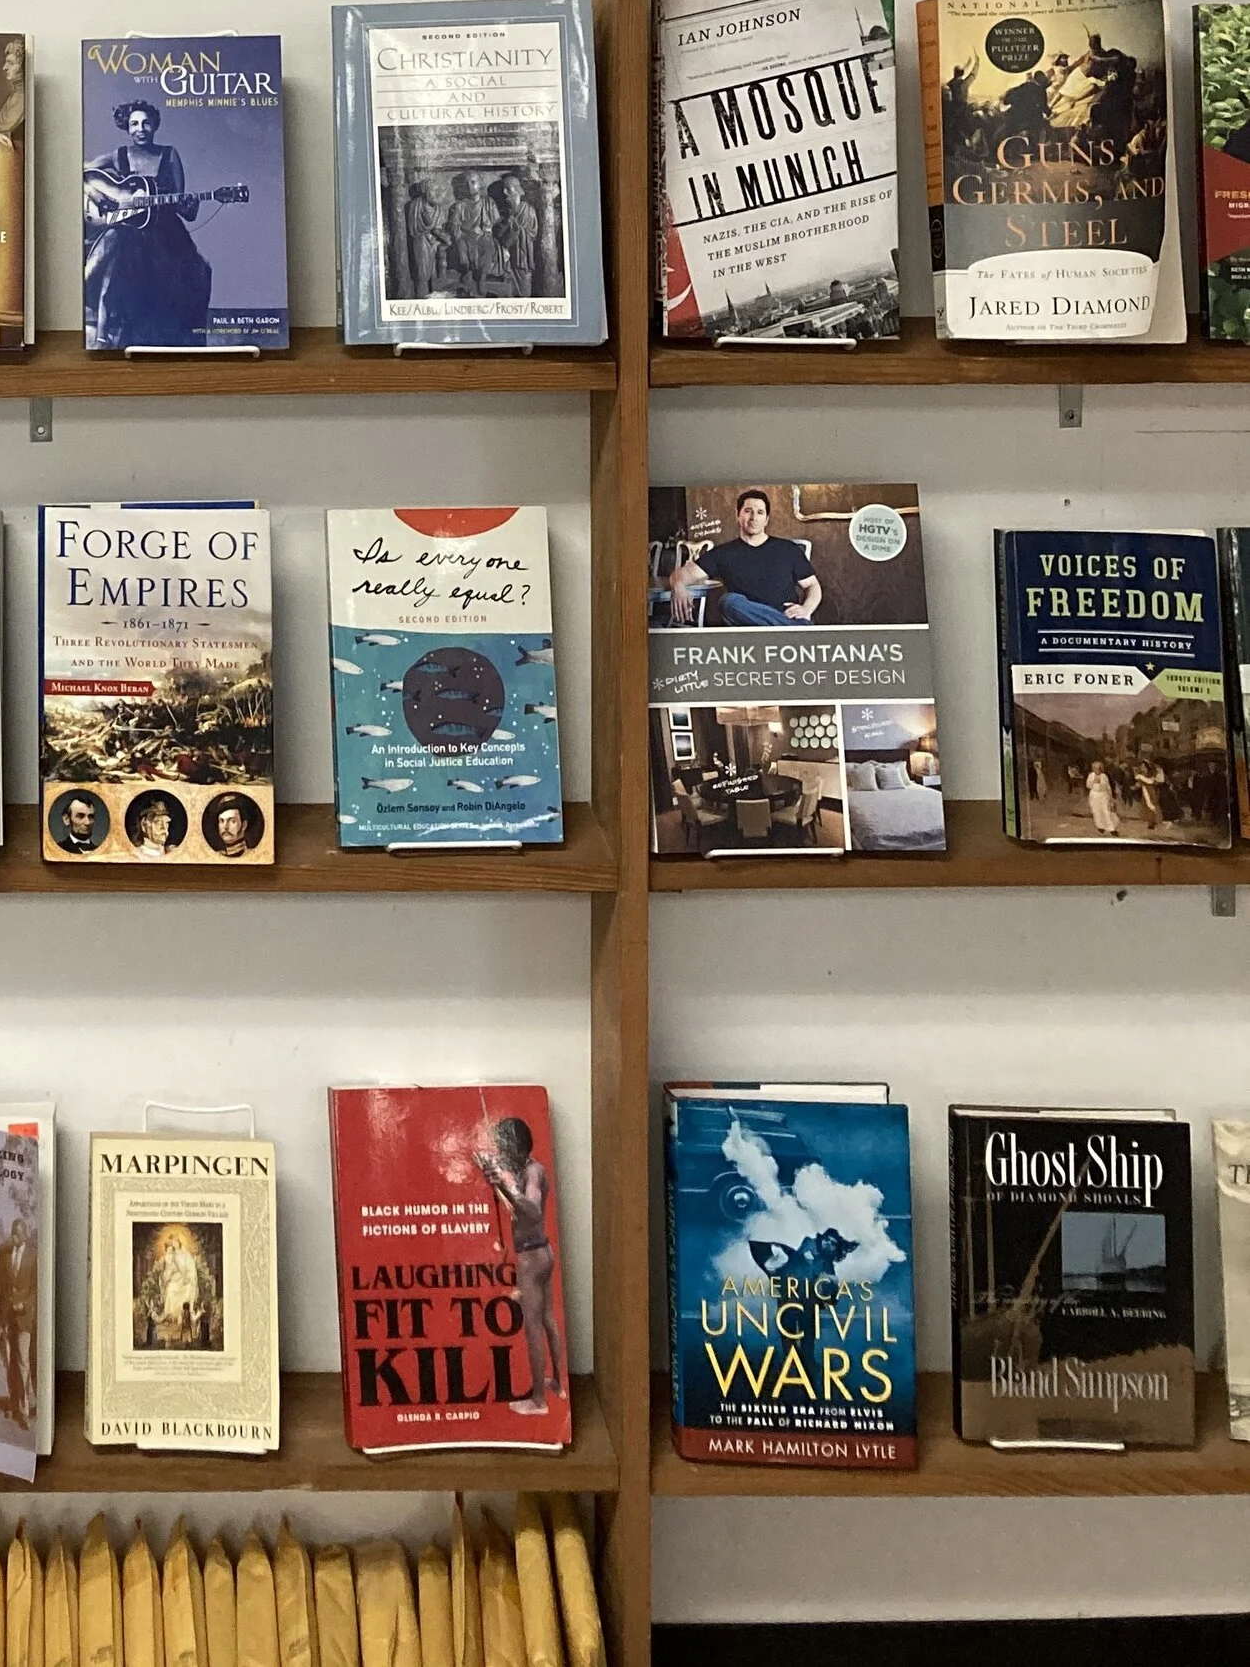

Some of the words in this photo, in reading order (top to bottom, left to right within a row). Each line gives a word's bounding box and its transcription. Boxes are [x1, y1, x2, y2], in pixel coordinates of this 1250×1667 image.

[88, 43, 221, 76] WOMAN
[377, 47, 553, 72] CHRISTIANITY
[134, 75, 158, 84] WITH
[161, 64, 277, 96] GUITAR
[675, 100, 700, 160] A
[710, 53, 886, 150] MOSQUE
[997, 135, 1128, 172] GUNS,
[689, 171, 724, 222] IN
[736, 140, 863, 212] MUNICH
[952, 172, 1104, 209] GERMS,
[1115, 176, 1164, 200] AND
[1006, 216, 1127, 249] STEEL
[57, 520, 191, 562] FORGE
[209, 530, 259, 562] OF
[1040, 555, 1137, 579] VOICES
[1153, 557, 1186, 580] OF
[67, 567, 248, 609] EMPIRES
[1026, 587, 1204, 622] FREEDOM
[674, 646, 757, 665] FRANK
[765, 644, 904, 664] FONTANA'S
[714, 670, 797, 686] SECRETS
[802, 670, 826, 685] OF
[831, 668, 906, 684] DESIGN
[100, 1153, 269, 1176] MARPINGEN
[986, 1132, 1083, 1186] Ghost
[1088, 1134, 1163, 1208] Ship
[362, 1205, 400, 1216] BLACK
[404, 1204, 448, 1216] HUMOR
[452, 1204, 464, 1215] IN
[468, 1204, 489, 1215] THE
[363, 1223, 417, 1236] FICTIONS
[422, 1224, 437, 1235] OF
[441, 1222, 490, 1235] SLAVERY
[352, 1262, 517, 1292] LAUGHING
[722, 1276, 874, 1301] AMERICA'S
[355, 1298, 432, 1339] FIT
[451, 1296, 523, 1337] TO
[701, 1300, 897, 1343] UNCIVIL
[358, 1346, 536, 1407] KILL
[704, 1342, 892, 1404] WARS
[101, 1422, 151, 1437] DAVID
[162, 1423, 272, 1441] BLACKBOURN
[709, 1439, 754, 1456] MARK
[762, 1440, 850, 1458] HAMILTON
[856, 1442, 896, 1460] LYTLE
